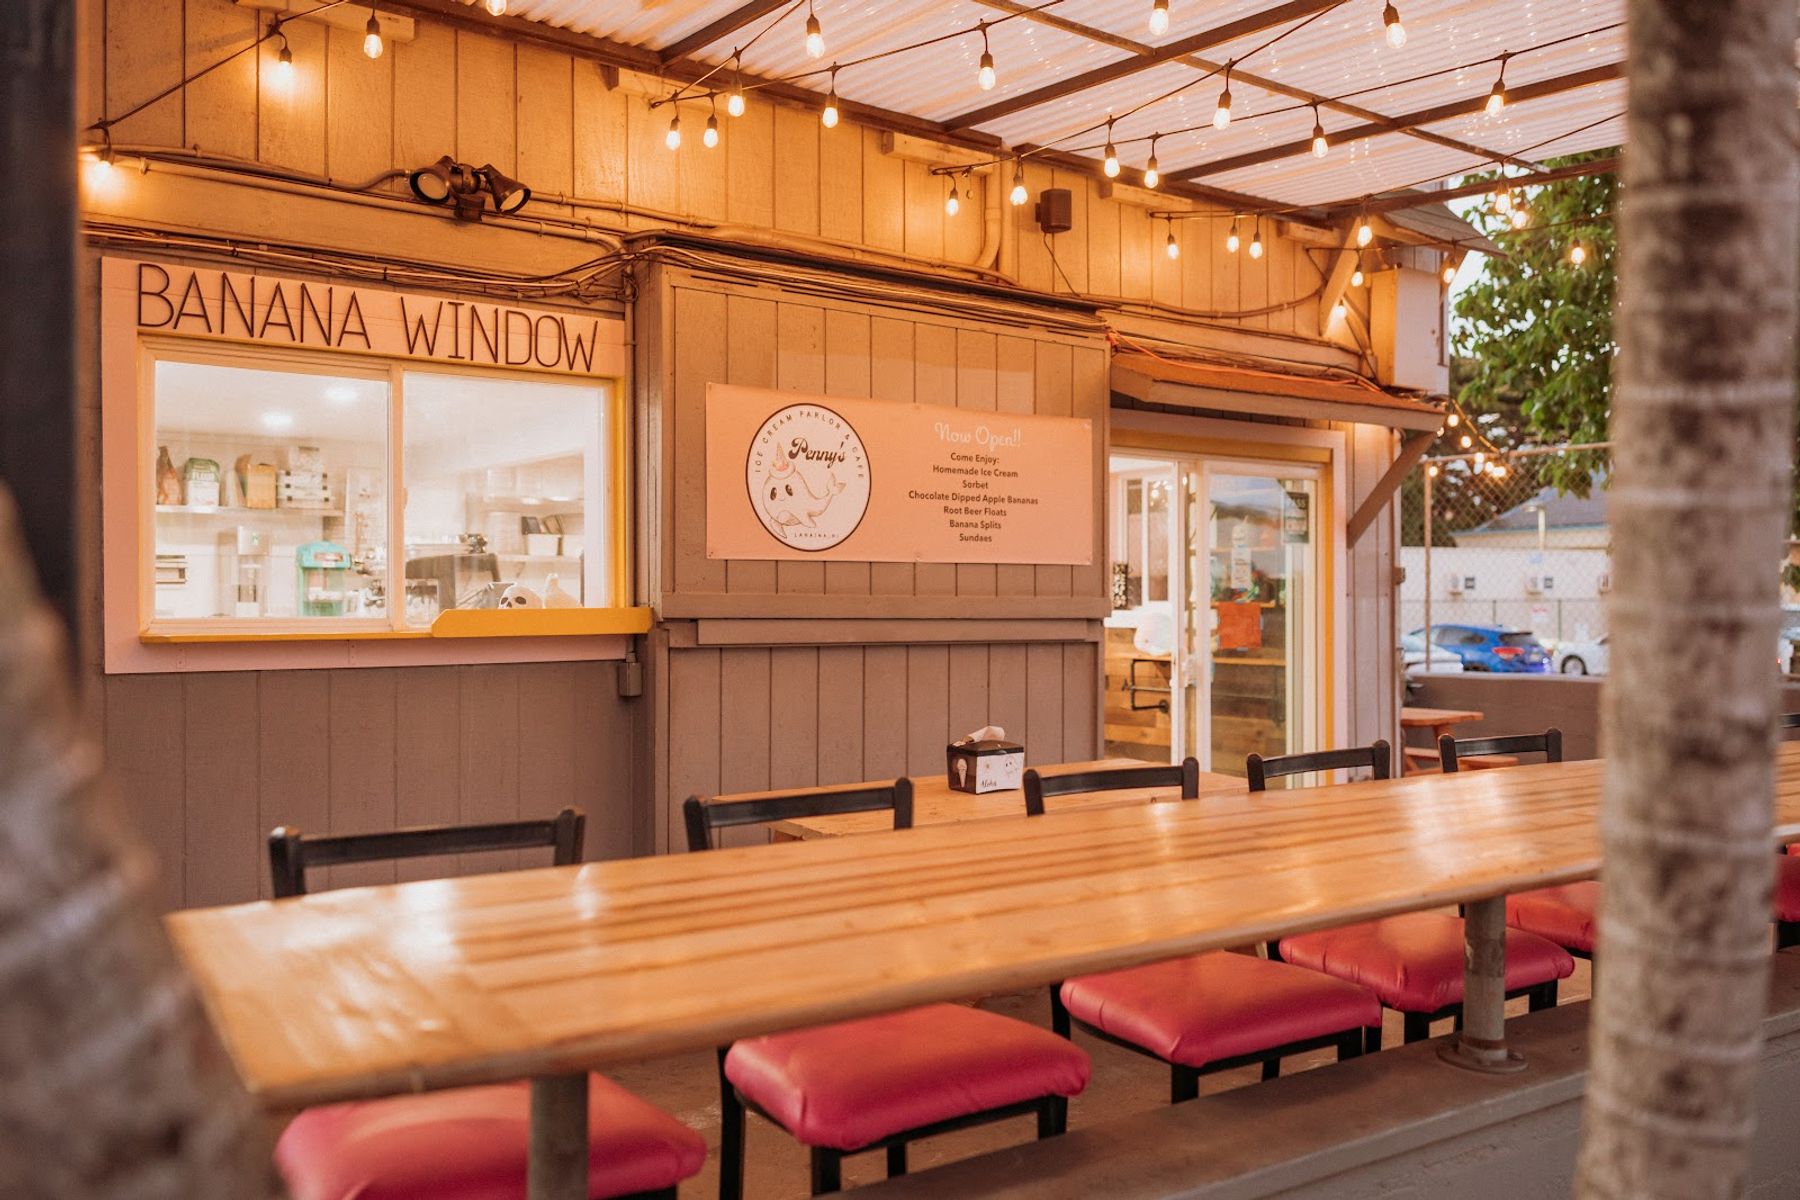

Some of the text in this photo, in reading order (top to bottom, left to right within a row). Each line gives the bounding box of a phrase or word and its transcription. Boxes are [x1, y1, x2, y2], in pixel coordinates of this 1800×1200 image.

[137, 263, 598, 373] BANANA WINDOW
[755, 451, 764, 473] ICE
[762, 414, 793, 444] CREAM
[799, 411, 841, 430] PARLOR
[934, 422, 1021, 452] Now Open!!
[788, 437, 846, 469] Penny's
[950, 452, 1000, 466] Come Enjoy:
[932, 465, 1018, 478] Homemade Ice Cream
[962, 480, 988, 489] Sorbet
[908, 490, 1039, 505] Chocolate Dipped Apple Bananas
[943, 506, 1007, 517] Root Beer Floats
[949, 519, 1002, 531] Banana Splits
[959, 533, 993, 542] Sundaes
